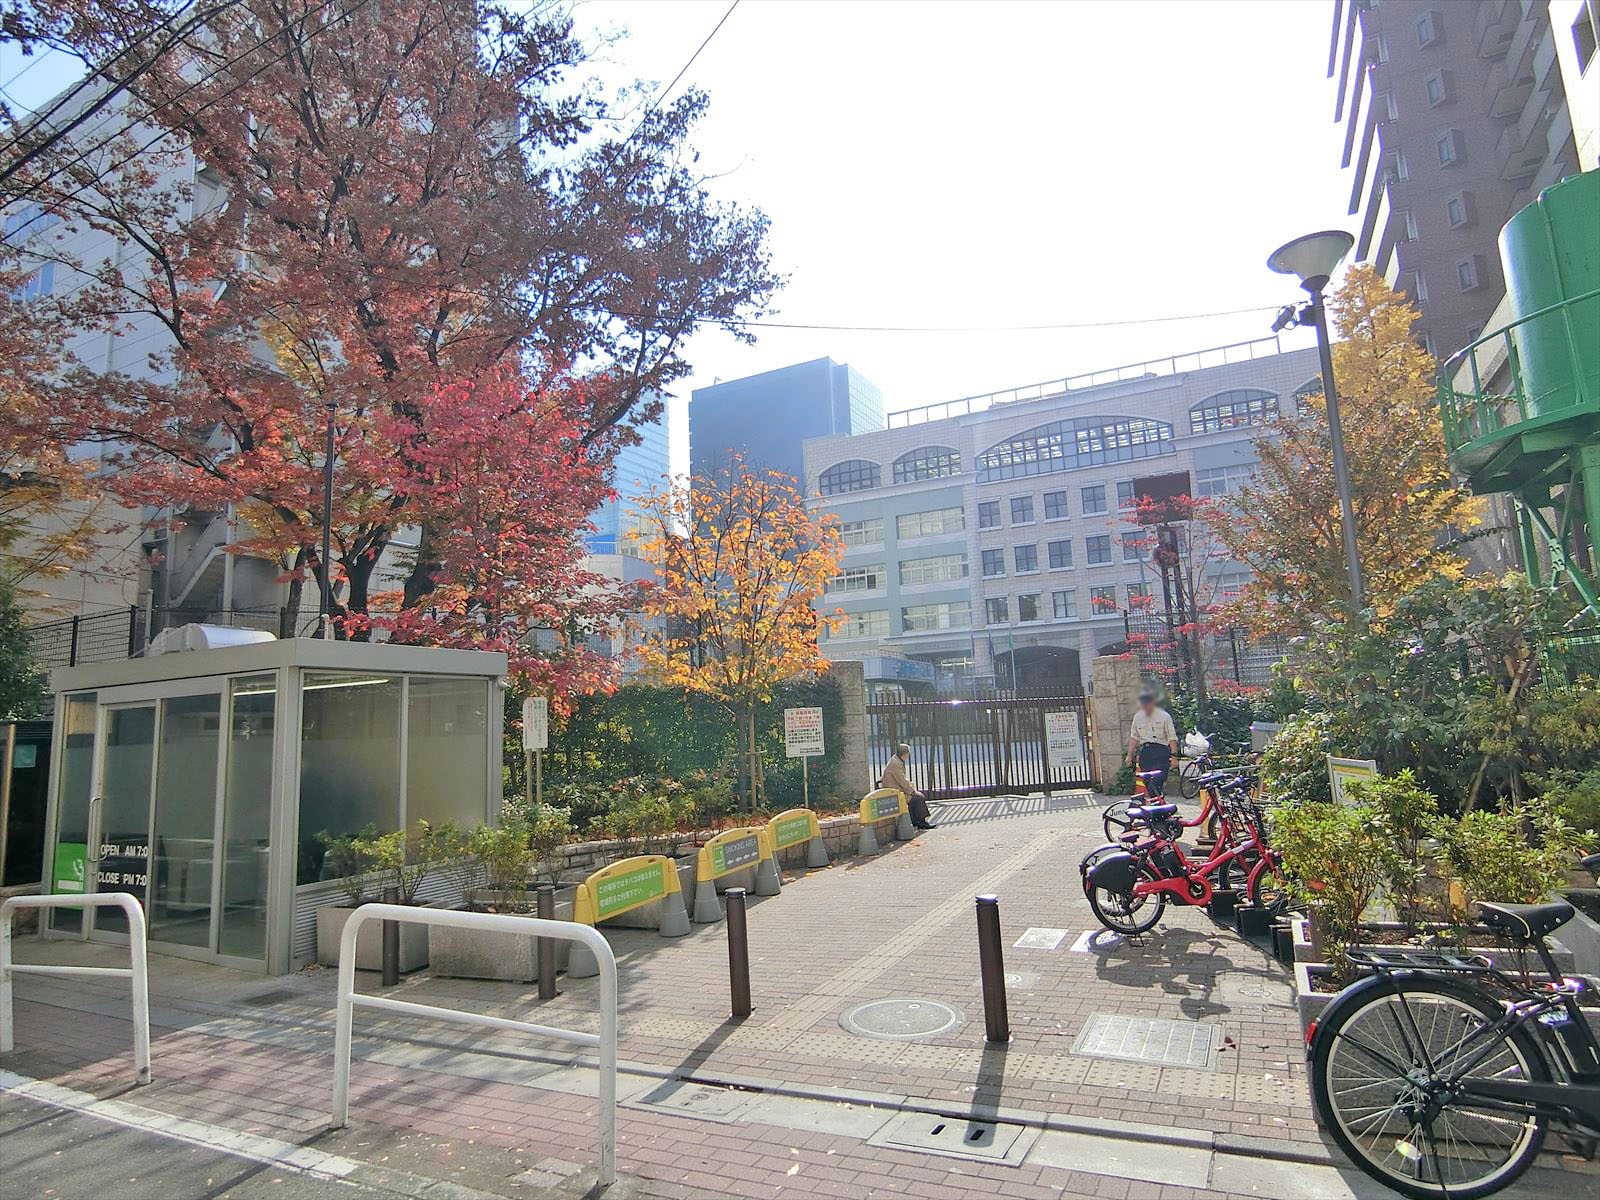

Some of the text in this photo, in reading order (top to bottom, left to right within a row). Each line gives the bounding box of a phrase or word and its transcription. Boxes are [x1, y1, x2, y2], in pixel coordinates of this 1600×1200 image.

[100, 844, 120, 856] OPEN
[124, 845, 136, 857] AM
[725, 838, 757, 854] SMOKING AREA
[97, 871, 120, 884] CLOSE
[123, 873, 134, 885] PM
